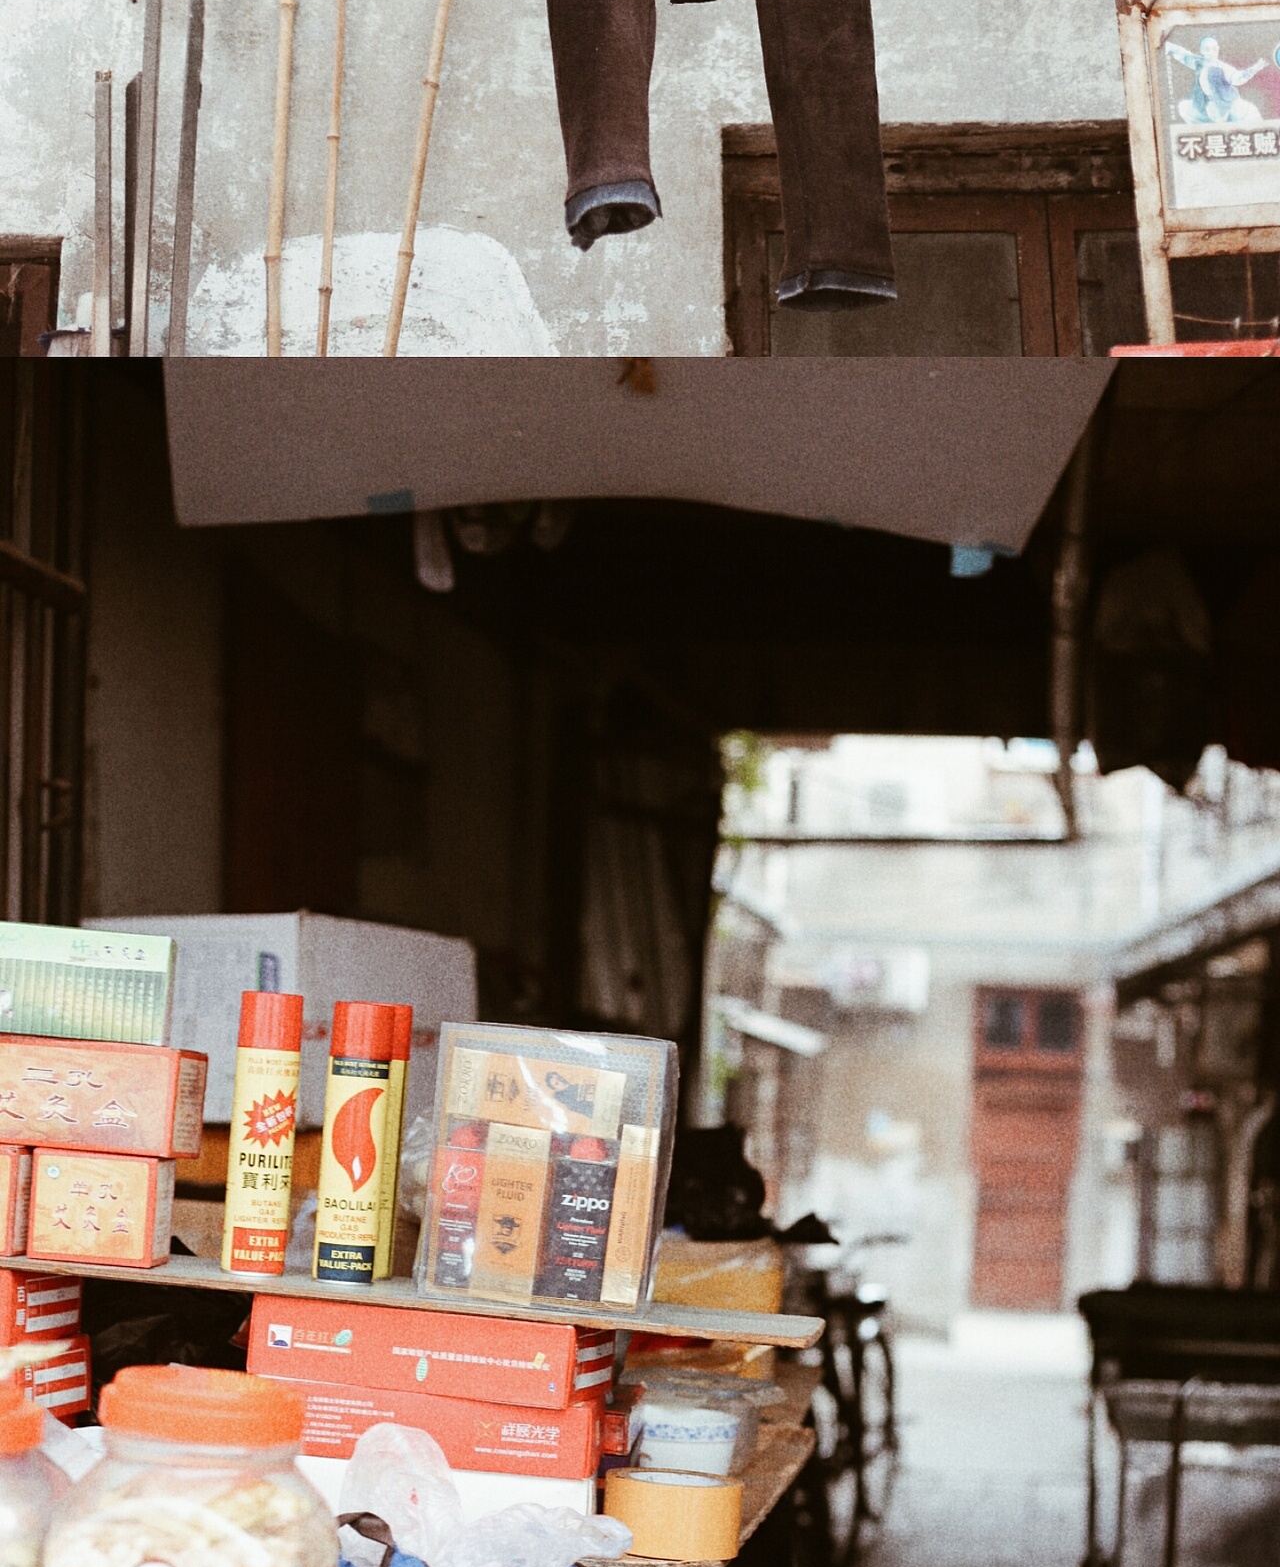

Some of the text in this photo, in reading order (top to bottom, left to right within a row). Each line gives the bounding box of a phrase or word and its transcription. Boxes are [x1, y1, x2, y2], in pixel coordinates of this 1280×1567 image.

[1178, 130, 1280, 160] 不是盗贼
[330, 1249, 364, 1261] EXTRA
[500, 1421, 561, 1441] 祥展光学
